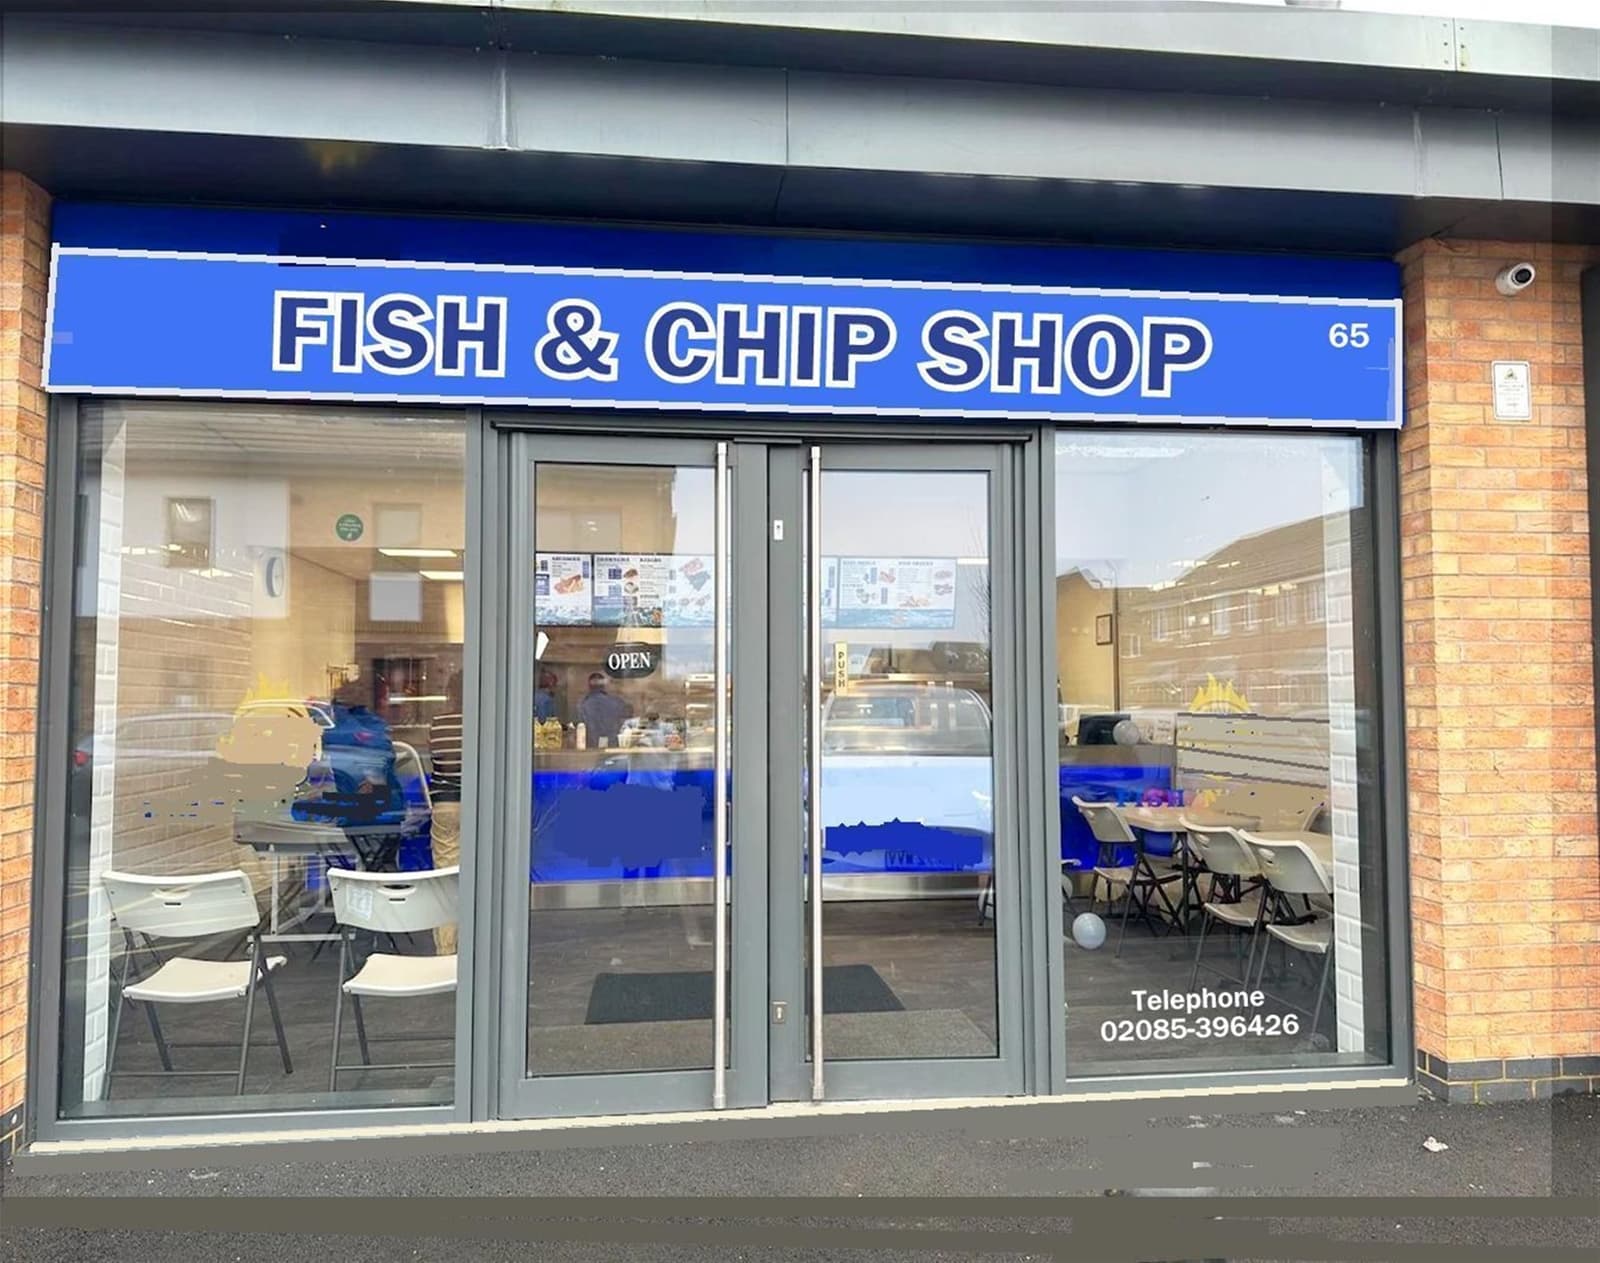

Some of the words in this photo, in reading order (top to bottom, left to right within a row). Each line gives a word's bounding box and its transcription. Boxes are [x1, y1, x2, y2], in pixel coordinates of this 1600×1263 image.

[272, 290, 508, 378] FISH
[535, 298, 620, 383] &
[645, 302, 897, 391] CHIP
[917, 309, 1213, 398] SHOP
[1329, 323, 1370, 348] 65
[608, 652, 651, 671] OPEN
[838, 651, 846, 688] PUSH
[1131, 988, 1265, 1014] Telephone
[1100, 1014, 1300, 1042] 02085-396426
